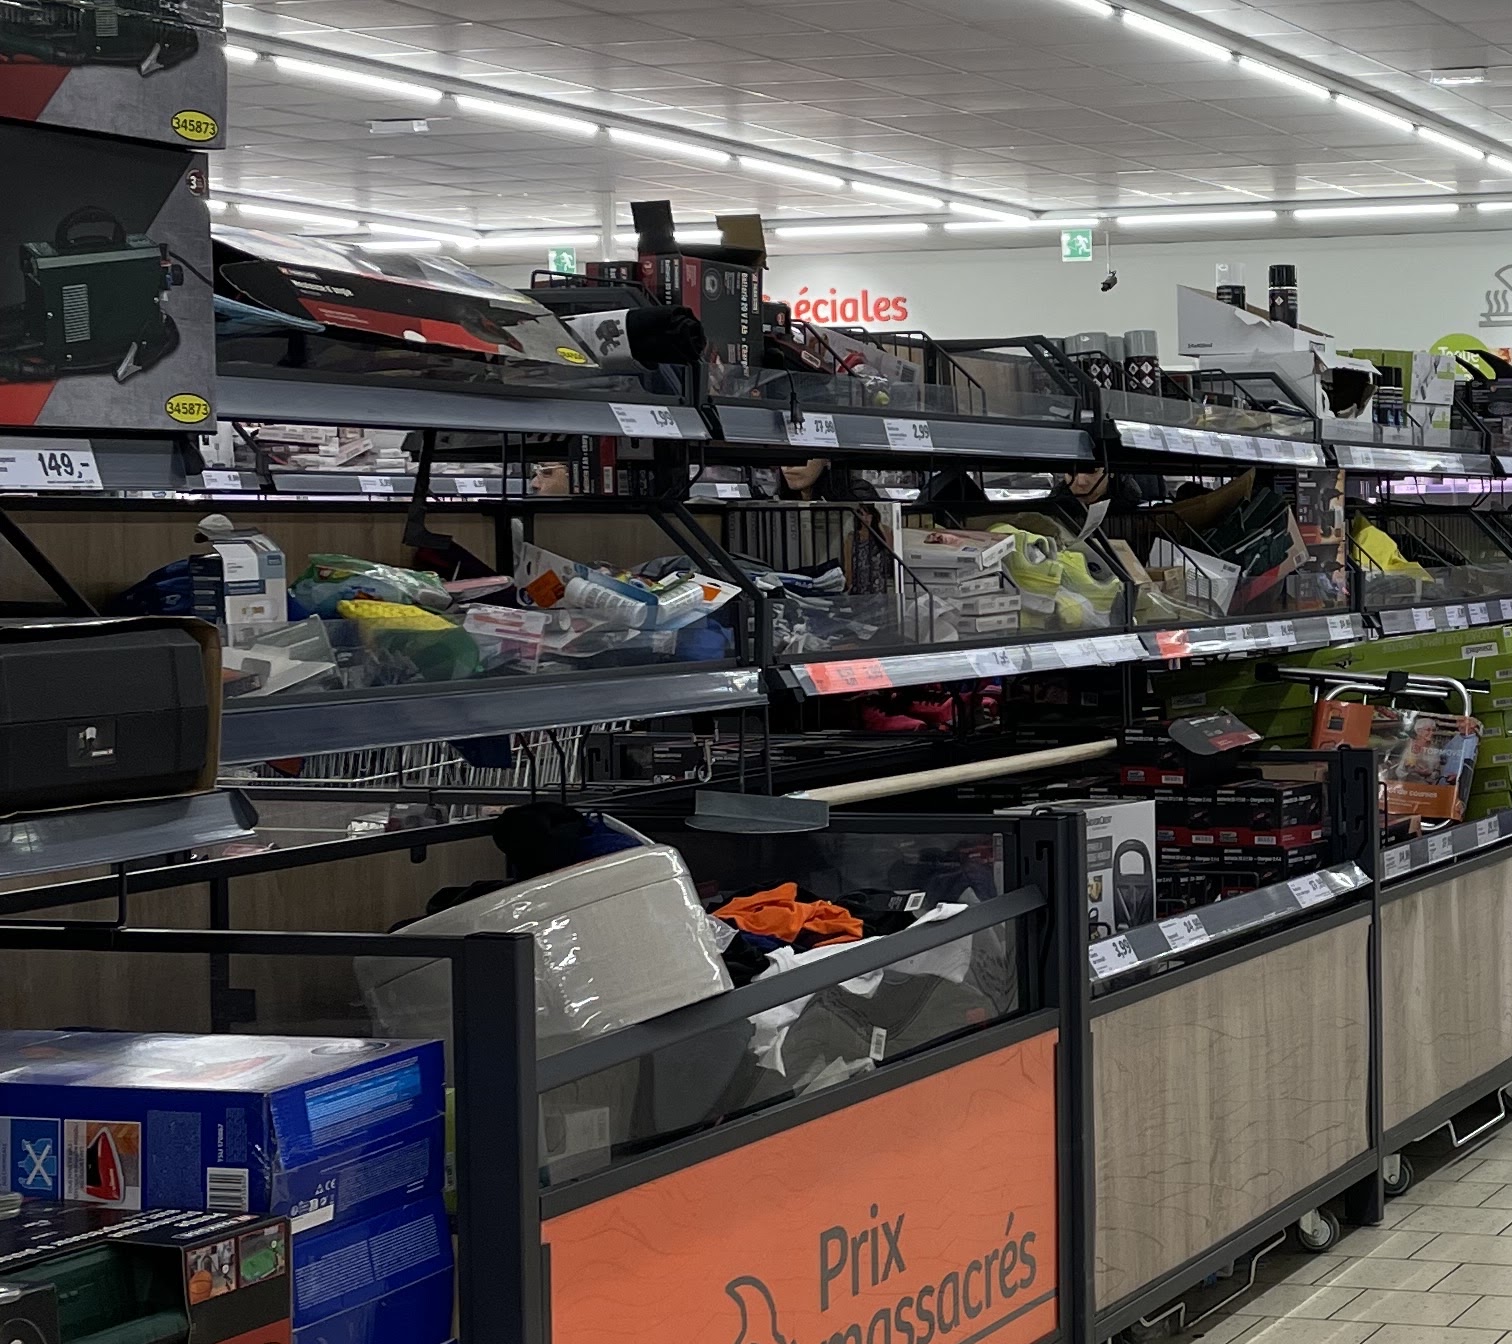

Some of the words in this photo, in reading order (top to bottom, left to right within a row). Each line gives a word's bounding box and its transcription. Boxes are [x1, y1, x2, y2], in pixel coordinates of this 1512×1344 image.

[173, 117, 216, 135] 345873
[763, 286, 908, 324] éciales
[166, 402, 209, 417] 345873
[650, 409, 675, 427] 1,99
[912, 422, 930, 439] 2,99
[38, 452, 90, 480] 149,-
[820, 1203, 907, 1313] Prix
